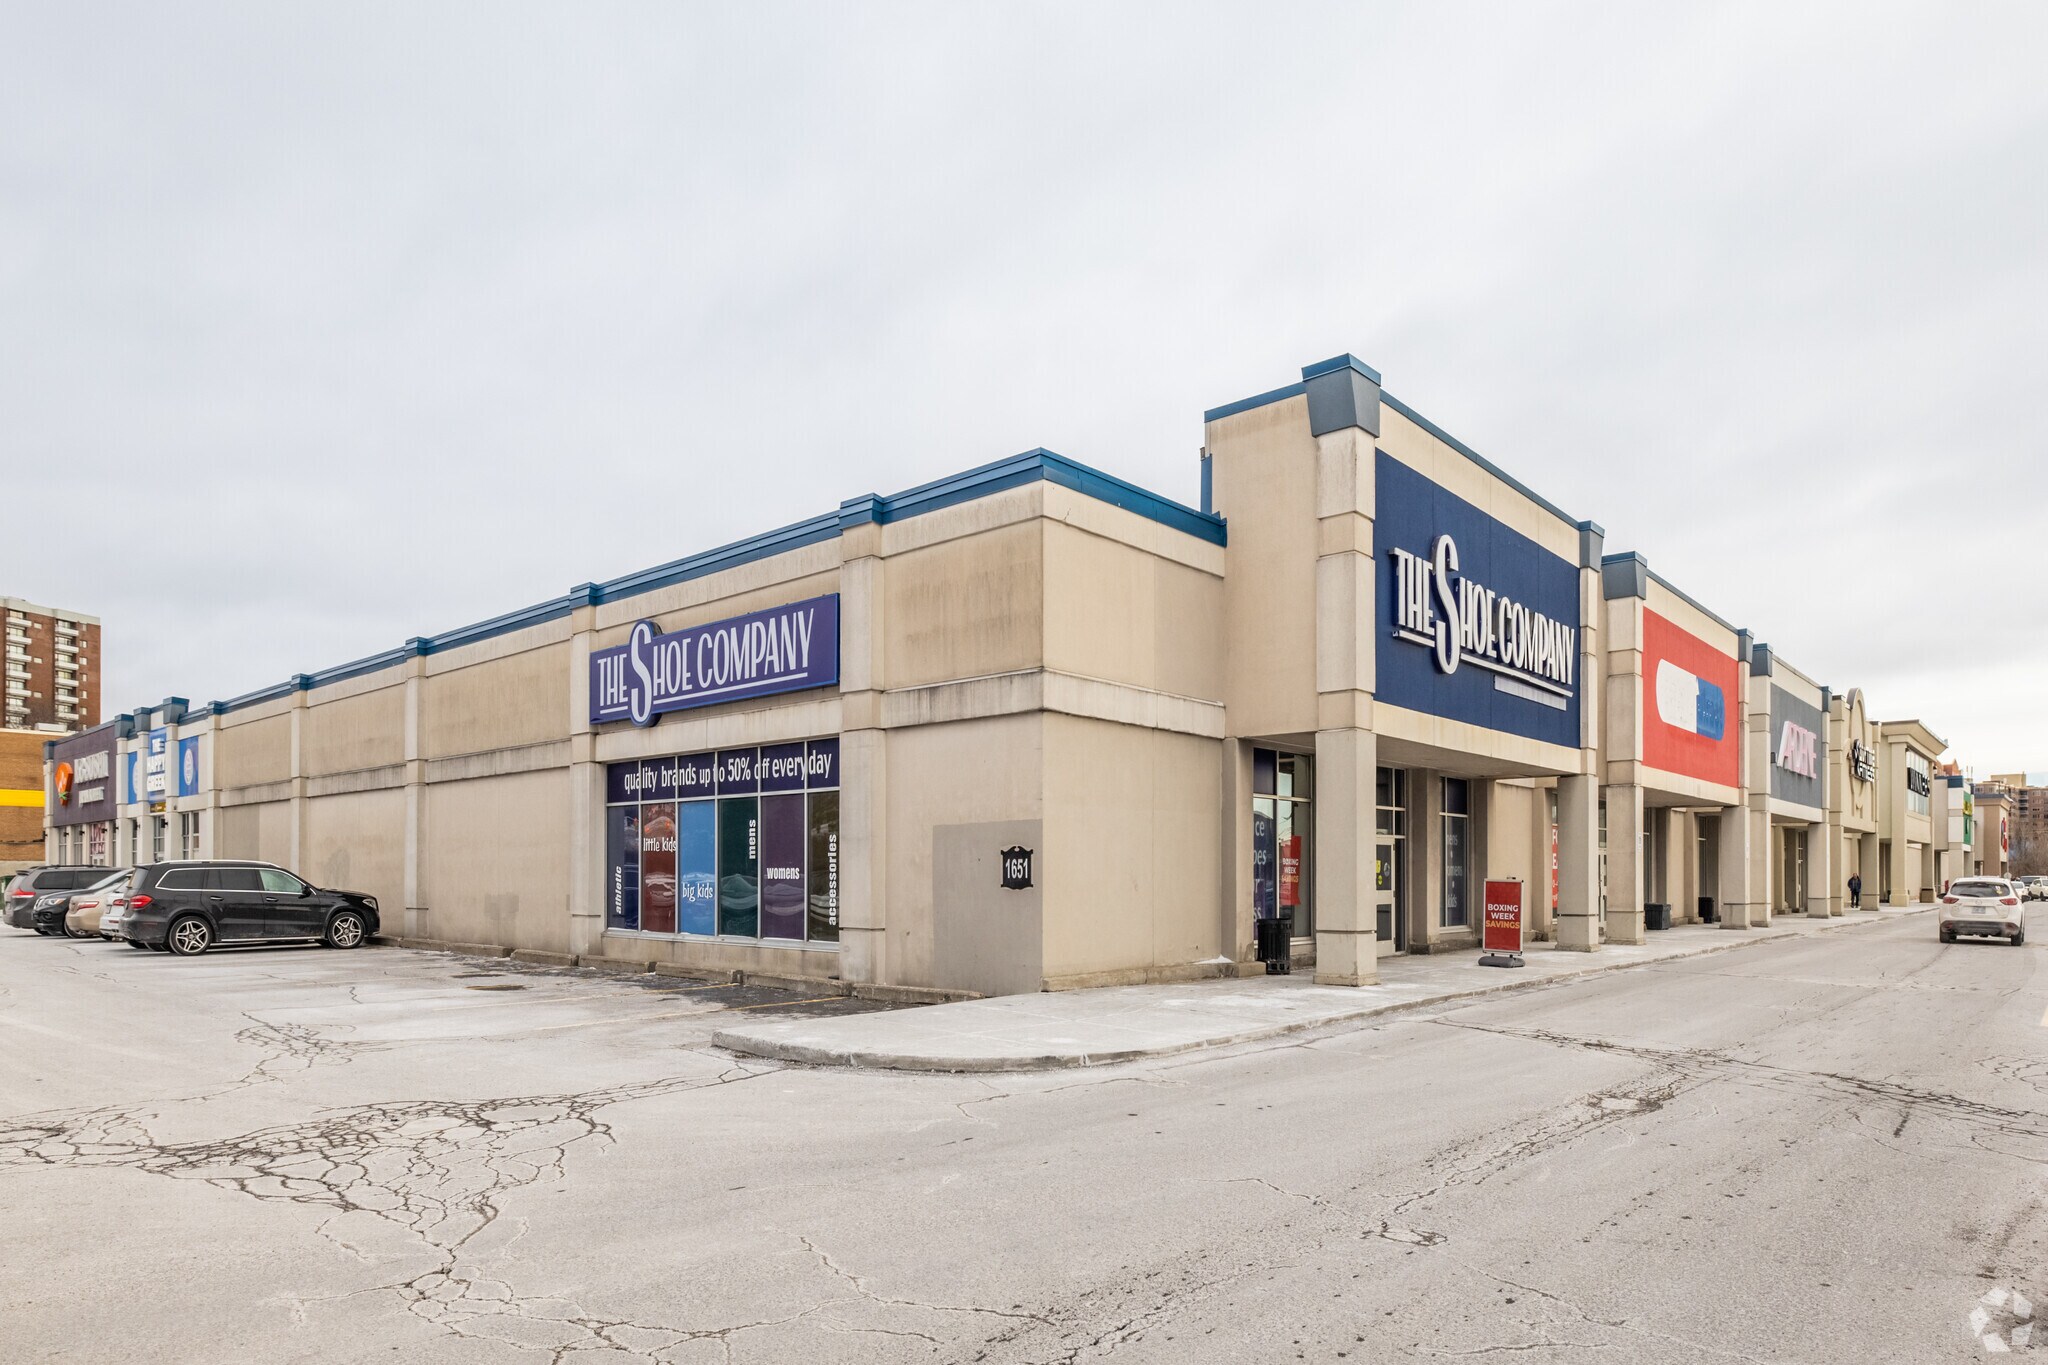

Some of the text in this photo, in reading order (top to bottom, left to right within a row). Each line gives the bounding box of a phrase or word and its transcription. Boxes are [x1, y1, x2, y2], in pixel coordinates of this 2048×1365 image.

[1392, 534, 1575, 685] THE SHOE COMPANY
[598, 608, 814, 722] THE SHOE COMPANY
[624, 766, 658, 795] quality
[661, 763, 697, 787] brands
[699, 767, 711, 788] up
[727, 756, 751, 782] 50%
[754, 757, 770, 779] off
[643, 836, 676, 853] little kids
[748, 819, 756, 860] mens
[766, 867, 800, 880] womens
[1005, 858, 1028, 879] 1651
[827, 833, 837, 926] accessories
[682, 882, 713, 902] big kids
[1487, 903, 1519, 912] BOXING
[1491, 912, 1515, 920] WEEK
[1485, 919, 1520, 929] SAVINGS
